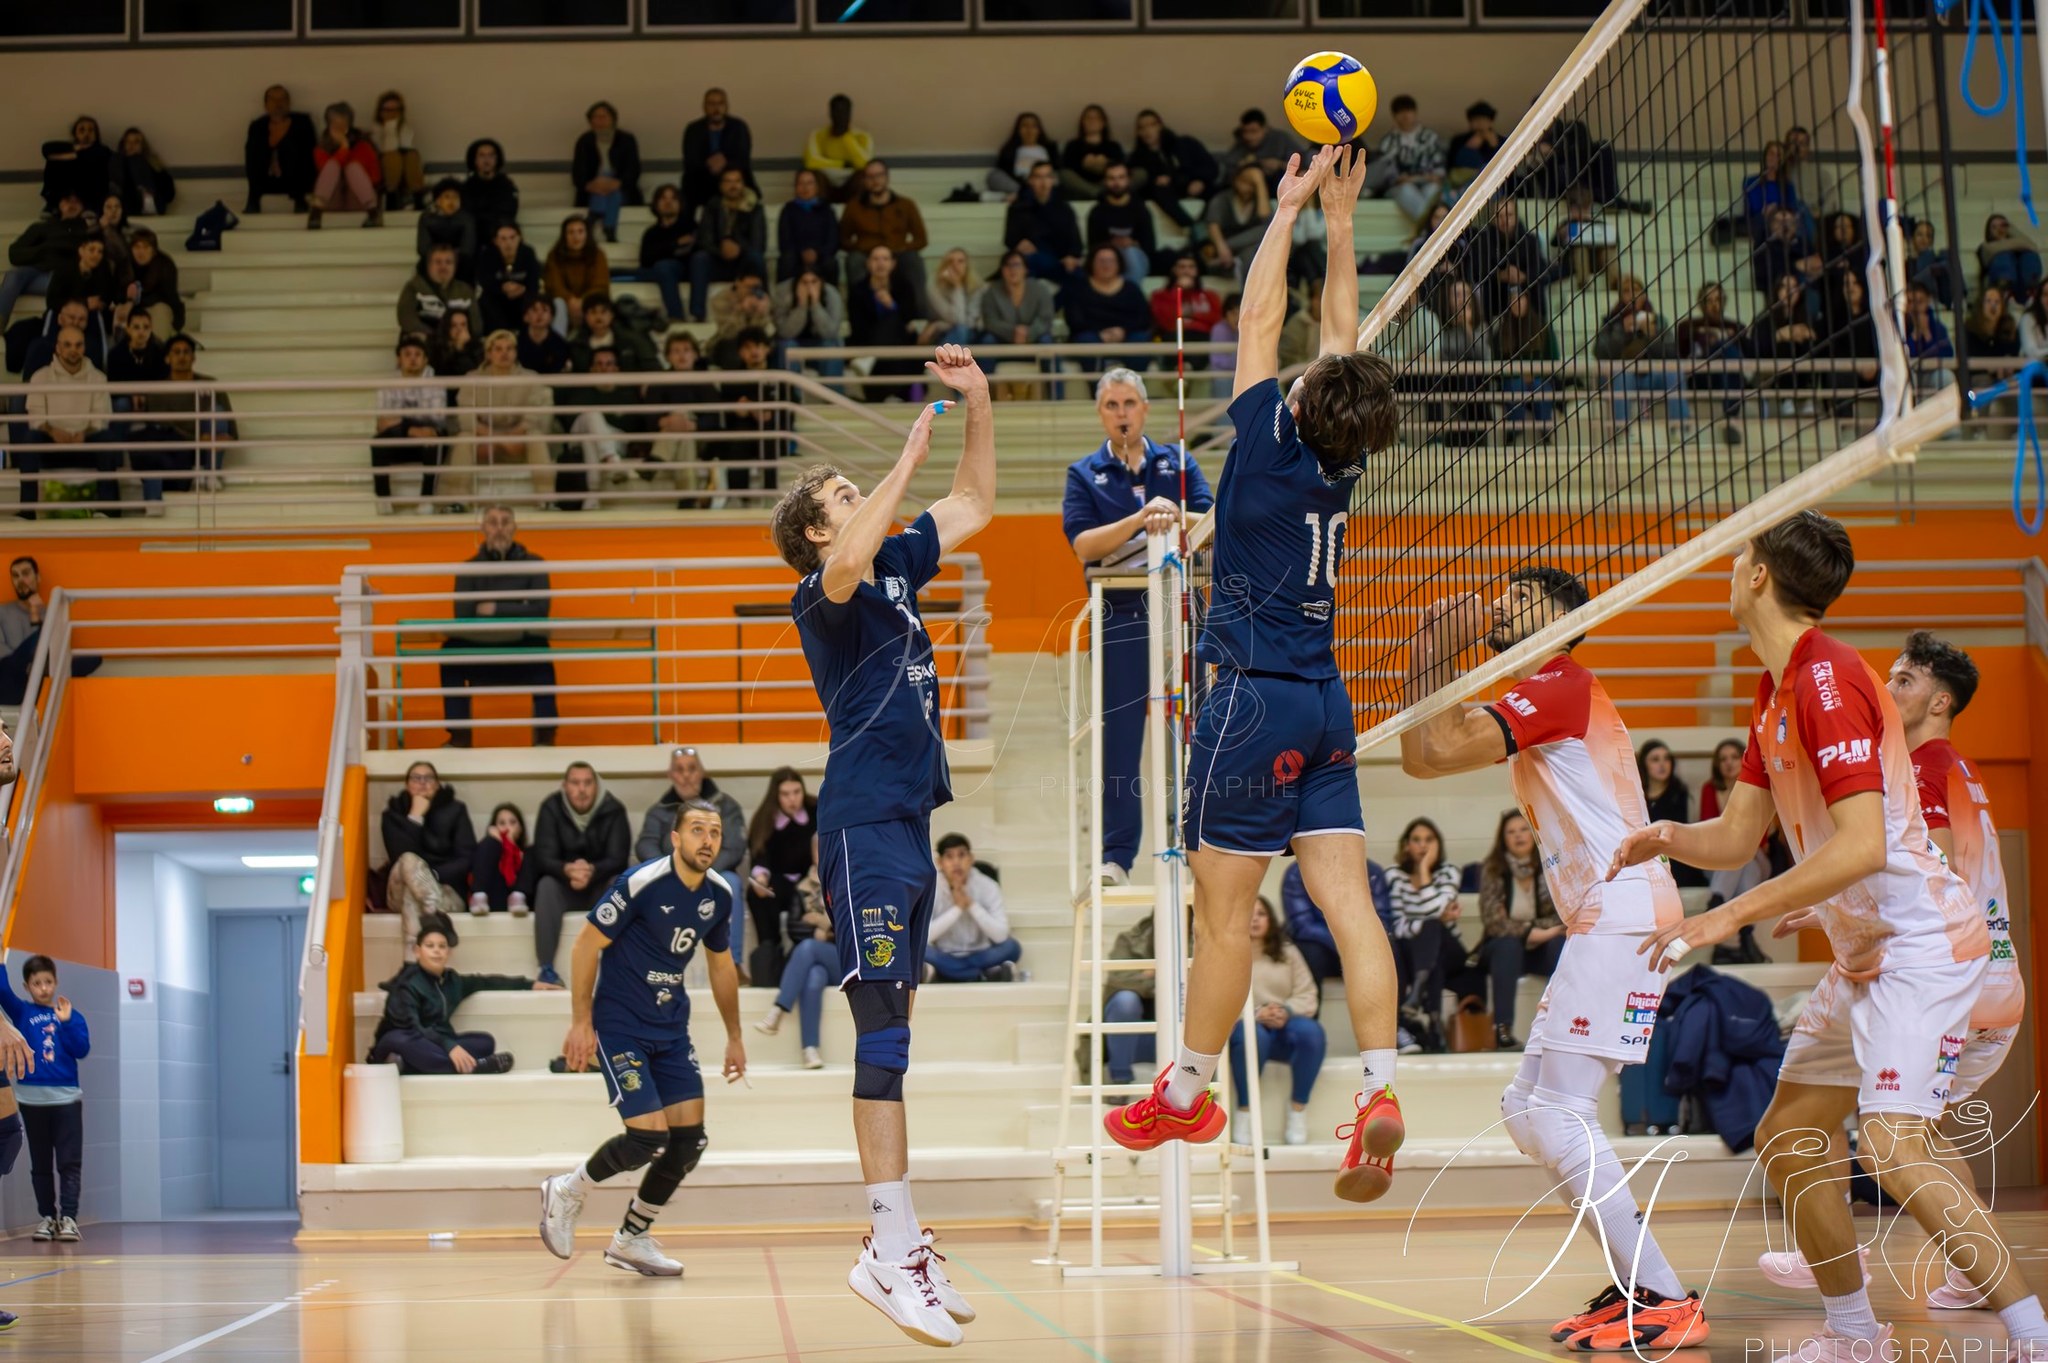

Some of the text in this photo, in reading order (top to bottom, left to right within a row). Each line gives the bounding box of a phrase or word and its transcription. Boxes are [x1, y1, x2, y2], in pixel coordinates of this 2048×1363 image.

[1815, 676, 1836, 711] LYON
[1817, 738, 1872, 769] PLM
[670, 926, 697, 954] 16
